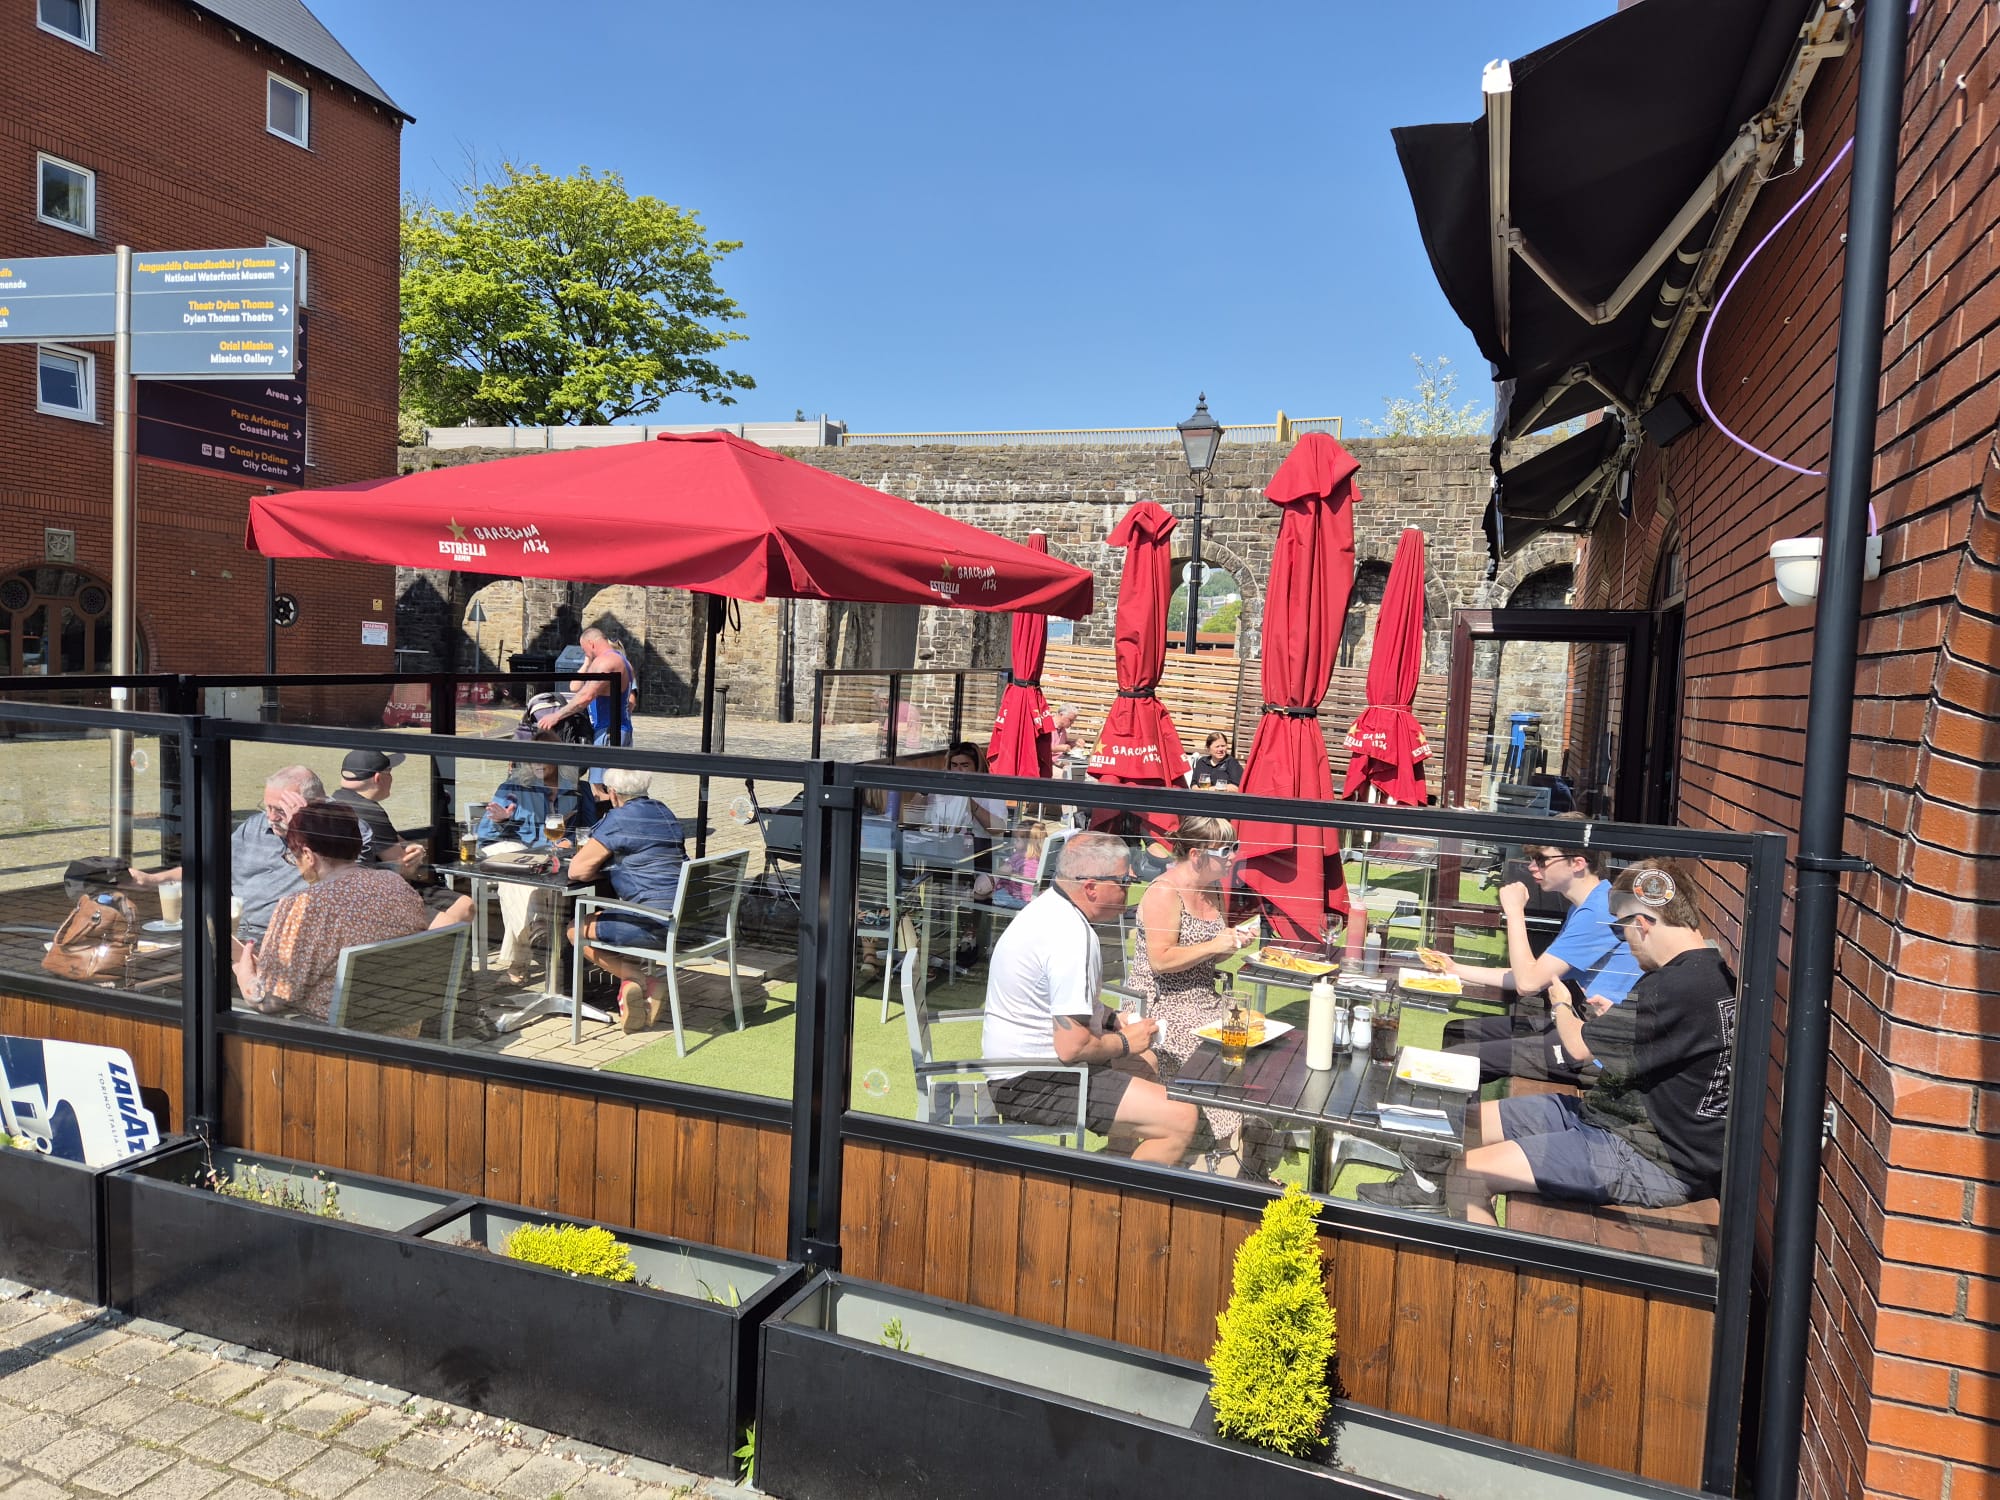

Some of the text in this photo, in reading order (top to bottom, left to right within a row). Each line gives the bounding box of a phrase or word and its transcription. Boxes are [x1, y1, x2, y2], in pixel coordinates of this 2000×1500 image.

[138, 258, 276, 273] Amgueddfa Genedlaethol y Glannau
[165, 270, 275, 283] National Waterfront Museum
[188, 299, 274, 312] Theatr Dylan Thomas
[183, 312, 274, 325] Dylan Thomas Theatre
[220, 340, 274, 351] Oriel Mission
[210, 353, 274, 365] Mission Gallery
[265, 387, 289, 401] Arena
[231, 409, 289, 430] Parc Arfordirol
[239, 422, 289, 441] Coastal Park
[229, 445, 289, 465] Canol y Ddinas
[242, 459, 288, 476] City Centre
[438, 540, 487, 557] ESTRELLA
[522, 538, 550, 554] 1876
[930, 580, 960, 595] ESTRELLA
